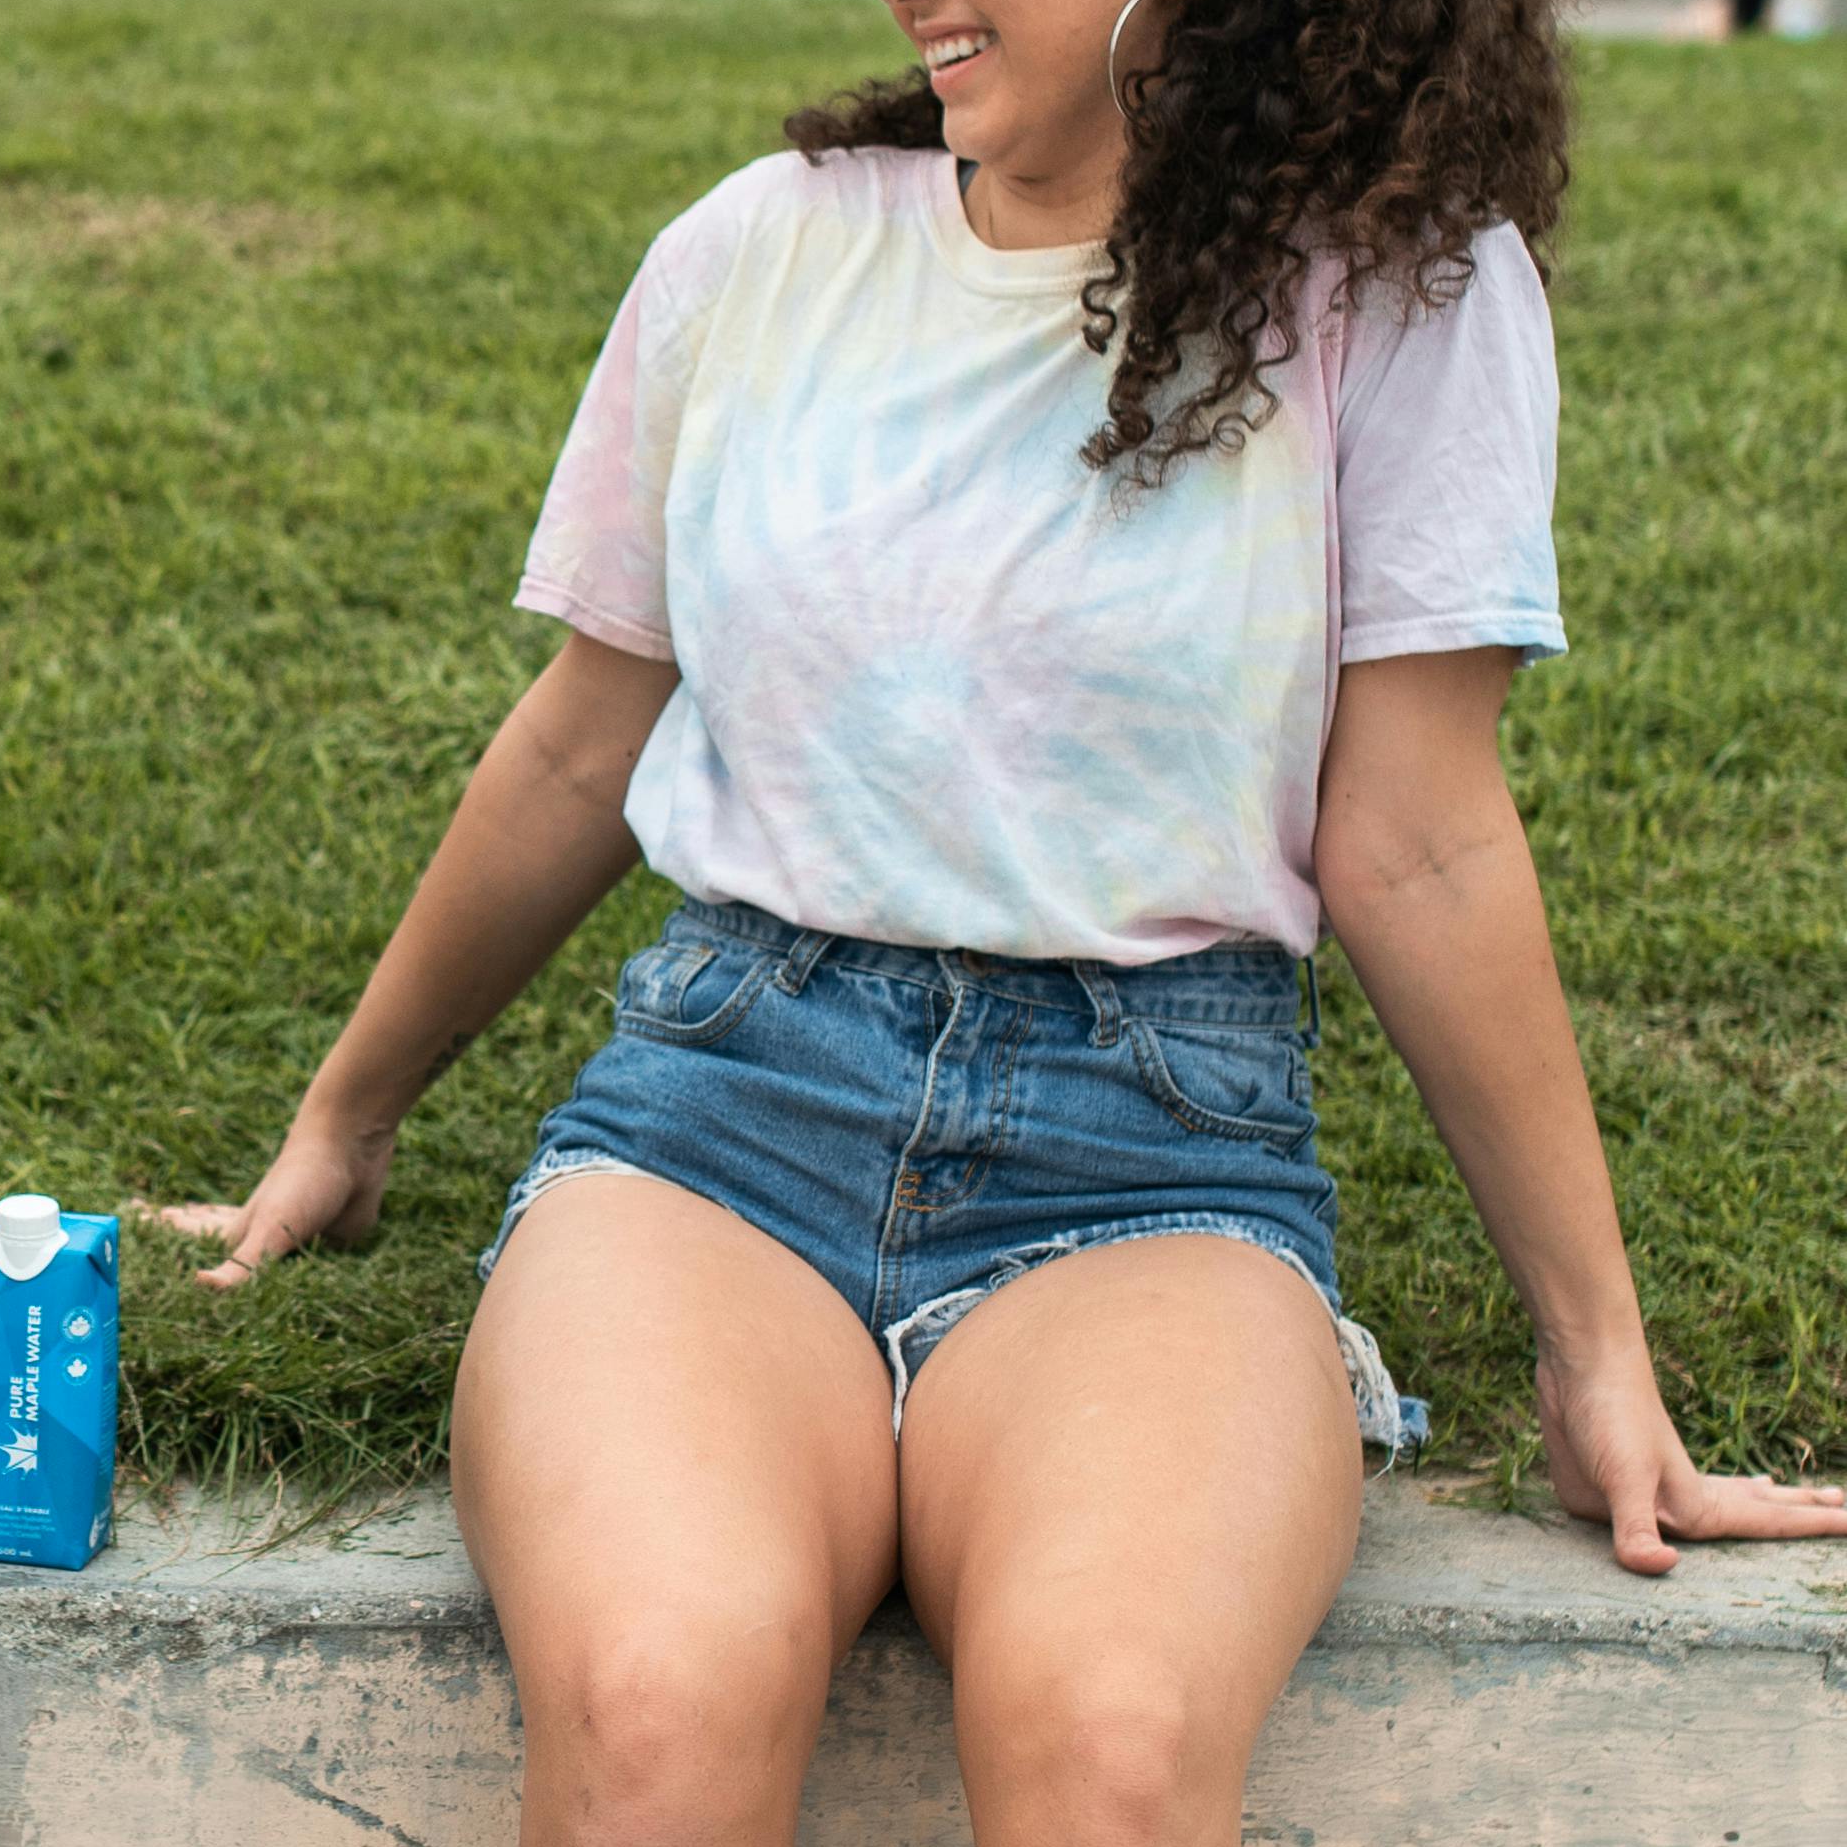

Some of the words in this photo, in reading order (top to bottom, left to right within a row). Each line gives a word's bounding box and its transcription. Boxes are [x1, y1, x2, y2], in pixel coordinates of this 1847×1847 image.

[27, 1305, 41, 1362] WATER
[10, 1376, 24, 1419] PURE
[25, 1365, 39, 1422] MAPLE
